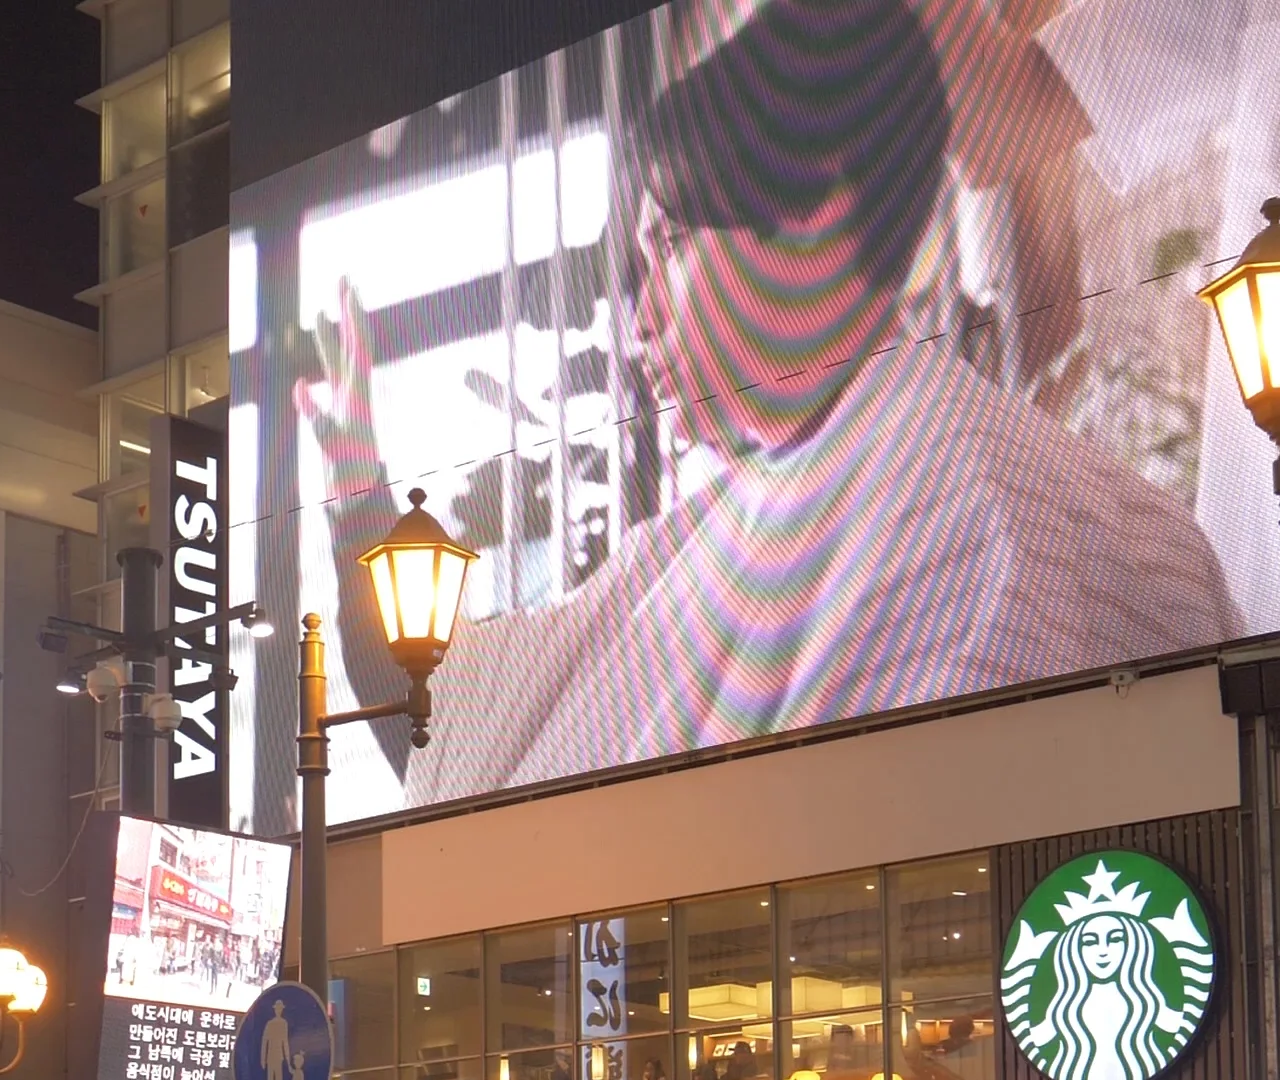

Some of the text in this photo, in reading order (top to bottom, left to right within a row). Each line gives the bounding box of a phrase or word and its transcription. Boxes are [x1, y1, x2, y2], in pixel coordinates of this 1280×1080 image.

[174, 457, 218, 781] TSUTAYA
[129, 1023, 178, 1046] 만들어진
[189, 1051, 215, 1068] 극장
